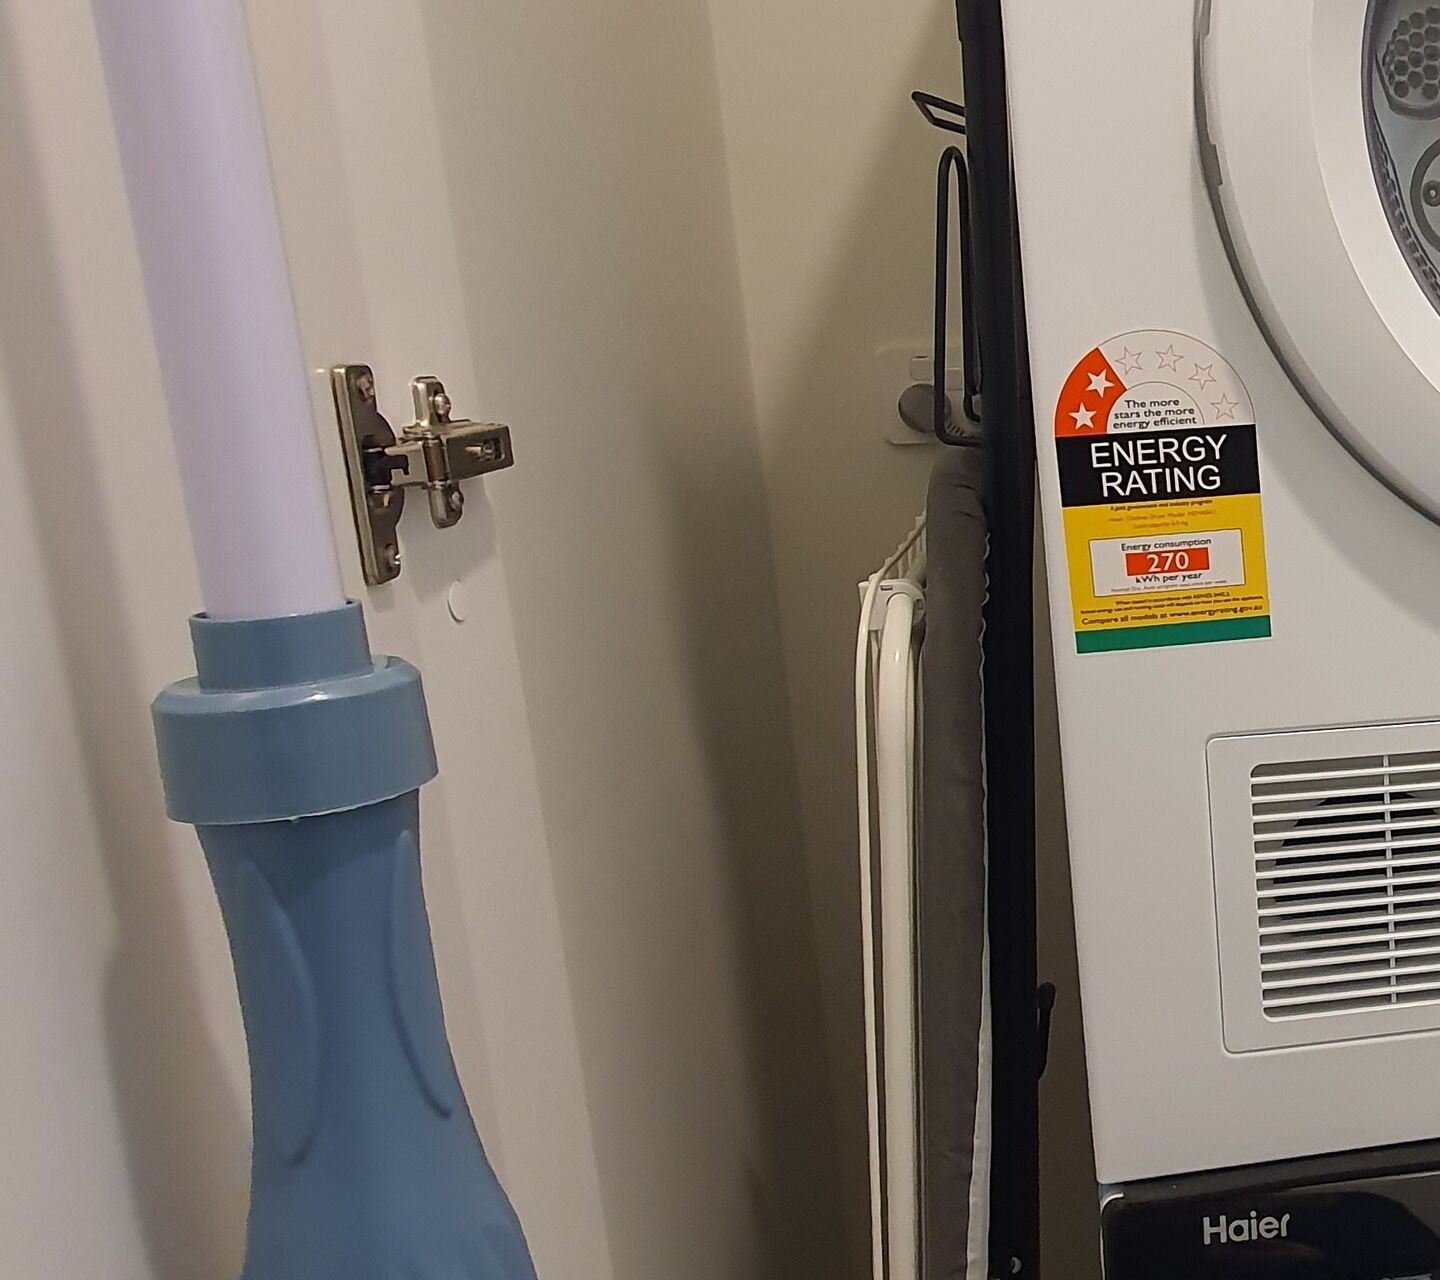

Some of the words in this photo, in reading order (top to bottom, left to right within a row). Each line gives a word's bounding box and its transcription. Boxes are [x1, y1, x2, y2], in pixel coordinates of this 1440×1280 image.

[1125, 399, 1147, 409] The
[1150, 398, 1180, 408] more
[1114, 409, 1141, 420] stars
[1144, 408, 1162, 418] the
[1165, 407, 1195, 416] more
[1113, 420, 1151, 430] energy
[1154, 416, 1198, 427] efficient
[1090, 433, 1228, 469] ENERGY
[1101, 464, 1222, 498] RATING
[1121, 542, 1151, 551] Energy
[1154, 538, 1212, 549] consumption
[1146, 551, 1189, 572] 270
[1136, 574, 1160, 584] kWh
[1163, 574, 1179, 583] per
[1182, 572, 1203, 582] year
[1081, 617, 1119, 625] Compare
[1131, 612, 1158, 621] models
[1202, 1209, 1291, 1246] Haier
